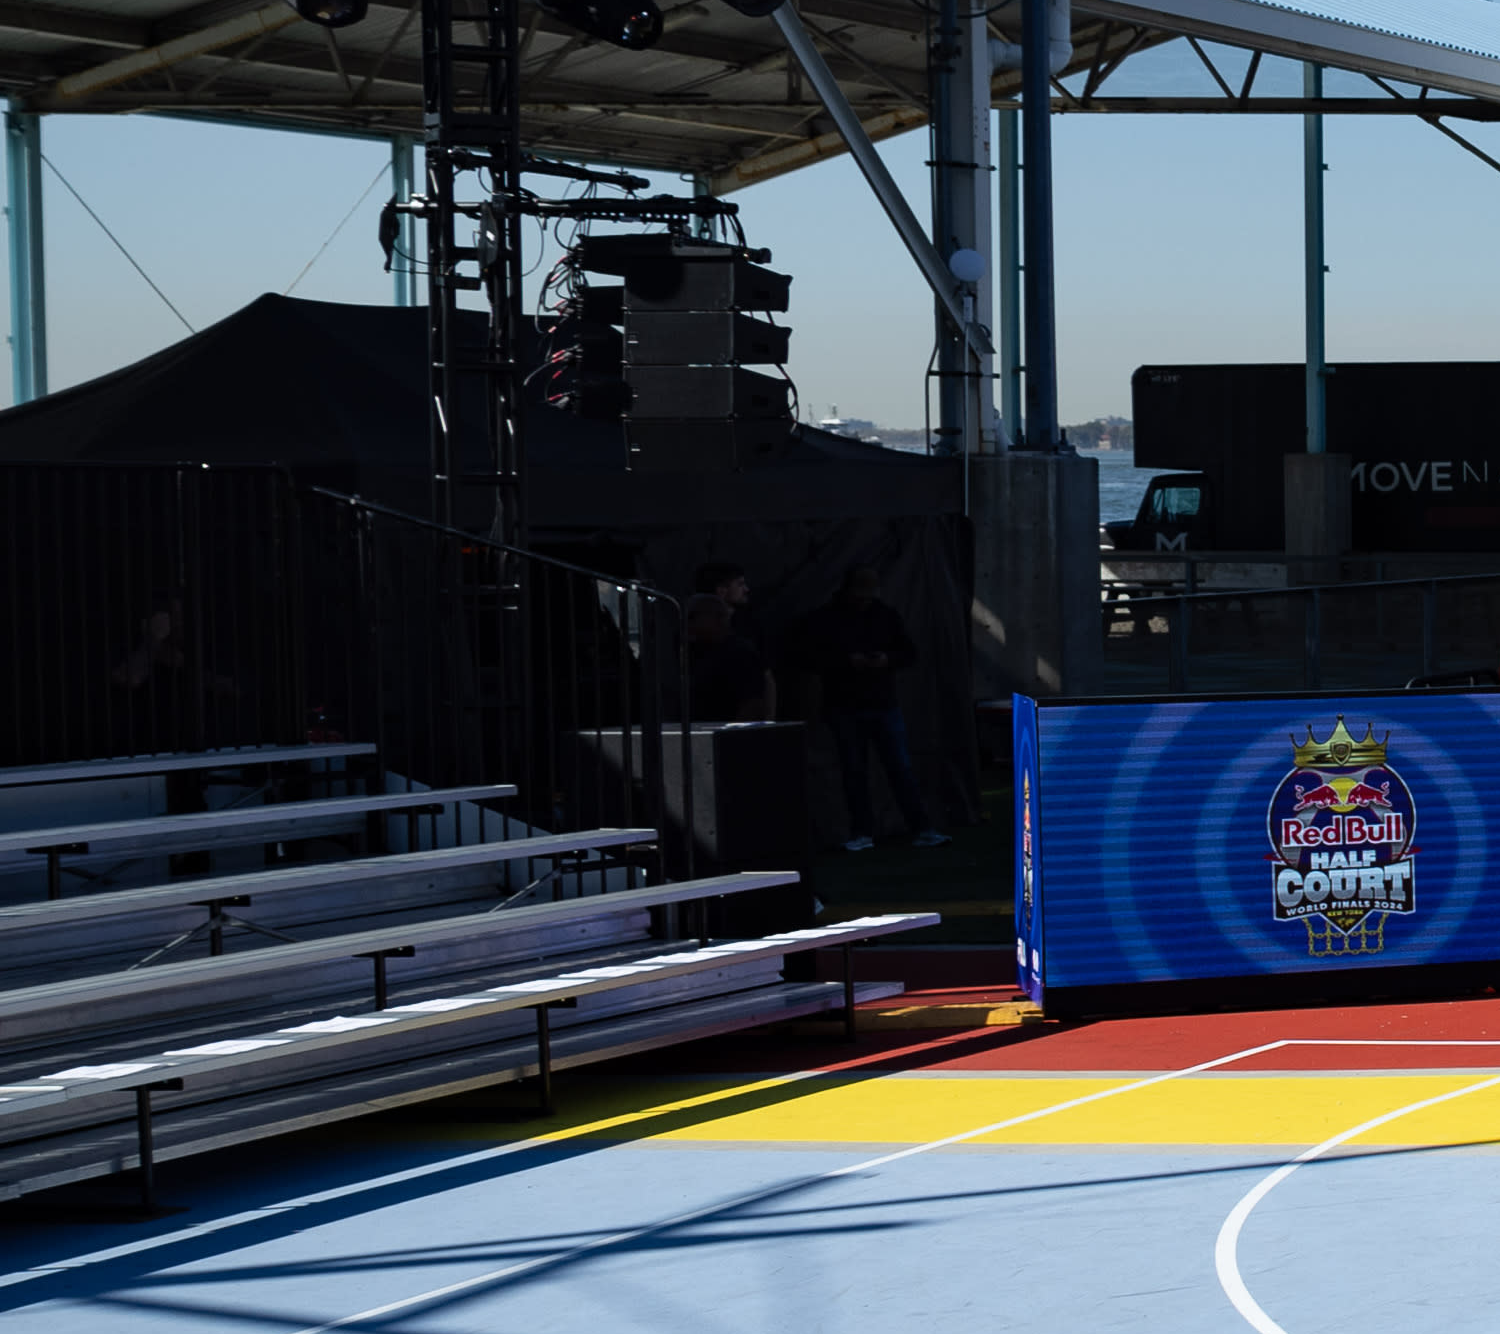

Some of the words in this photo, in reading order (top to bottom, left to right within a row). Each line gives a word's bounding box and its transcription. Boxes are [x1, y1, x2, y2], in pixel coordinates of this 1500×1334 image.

[1282, 814, 1342, 847] Red
[1345, 812, 1403, 843] Bull
[1311, 850, 1376, 869] HALF
[1277, 862, 1410, 907] COURT
[1286, 902, 1328, 916] WORLD
[1332, 900, 1371, 909] FINALS
[1374, 900, 1403, 910] 2024
